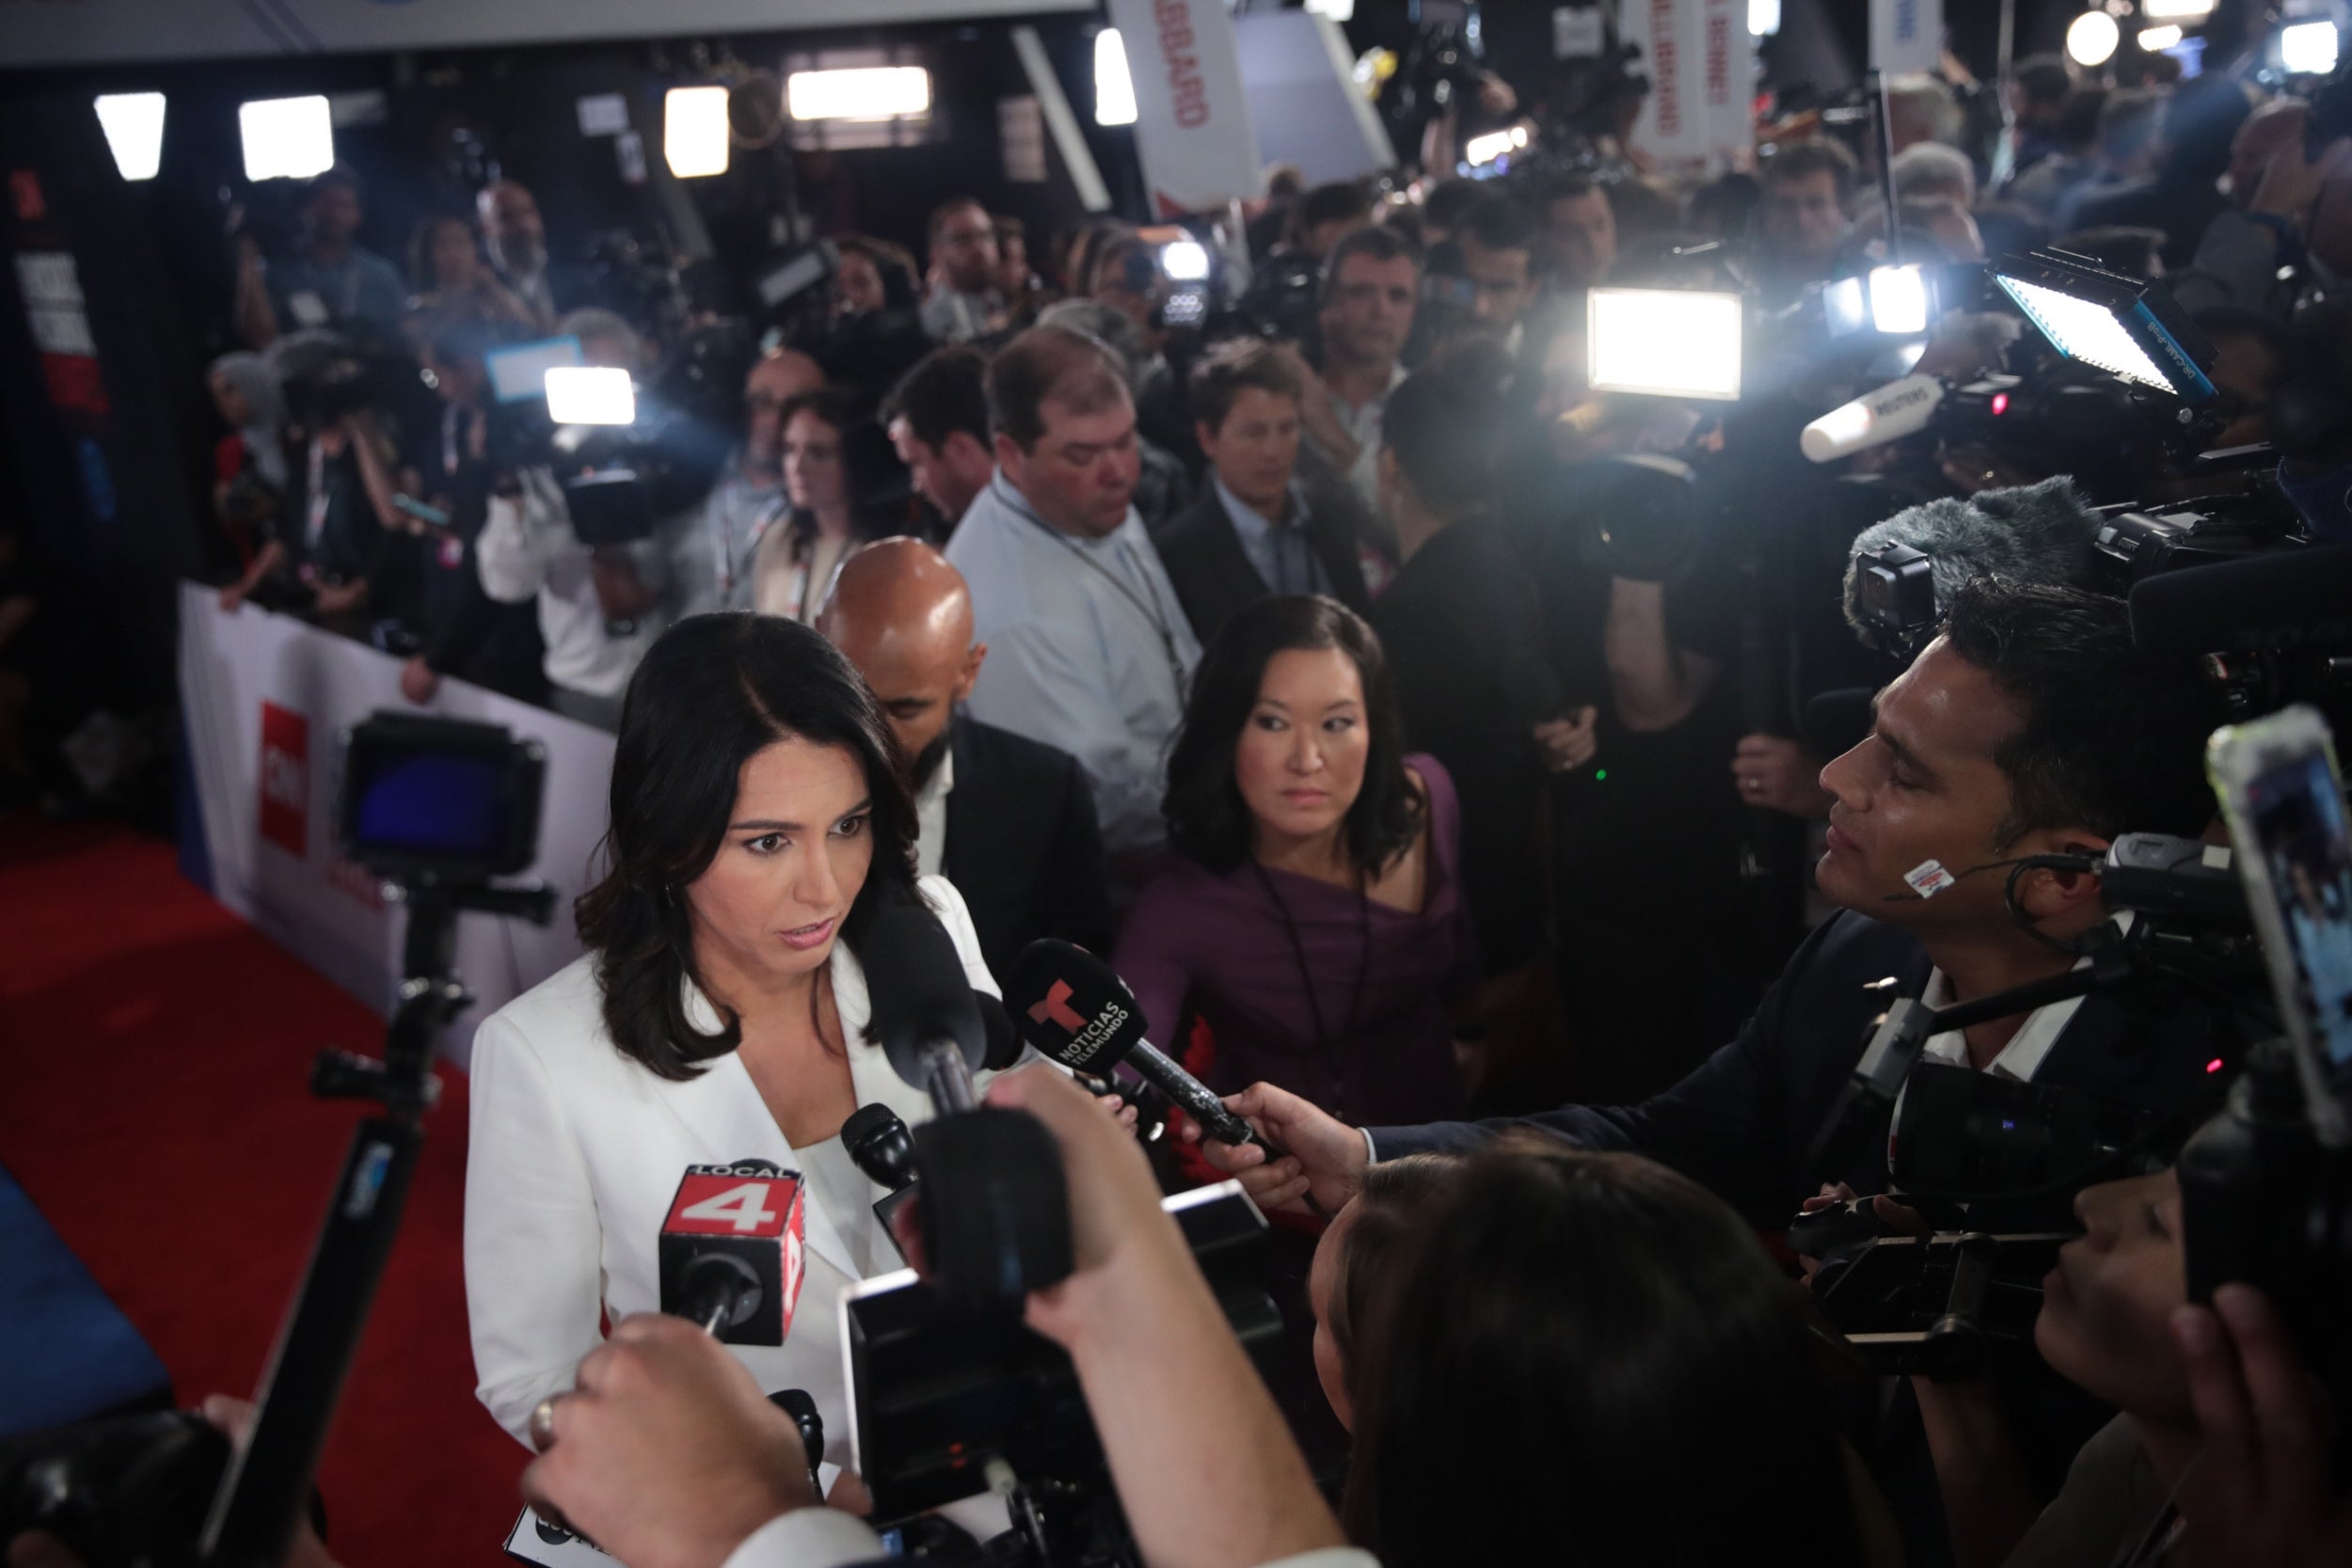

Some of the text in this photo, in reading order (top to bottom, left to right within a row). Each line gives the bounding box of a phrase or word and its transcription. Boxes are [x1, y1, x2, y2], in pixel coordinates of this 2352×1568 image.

[1058, 1001, 1120, 1060] NOTICIAS
[1072, 1009, 1129, 1066] TELEMUNDO
[695, 1164, 791, 1179] LOCAL
[680, 1182, 776, 1231] 4
